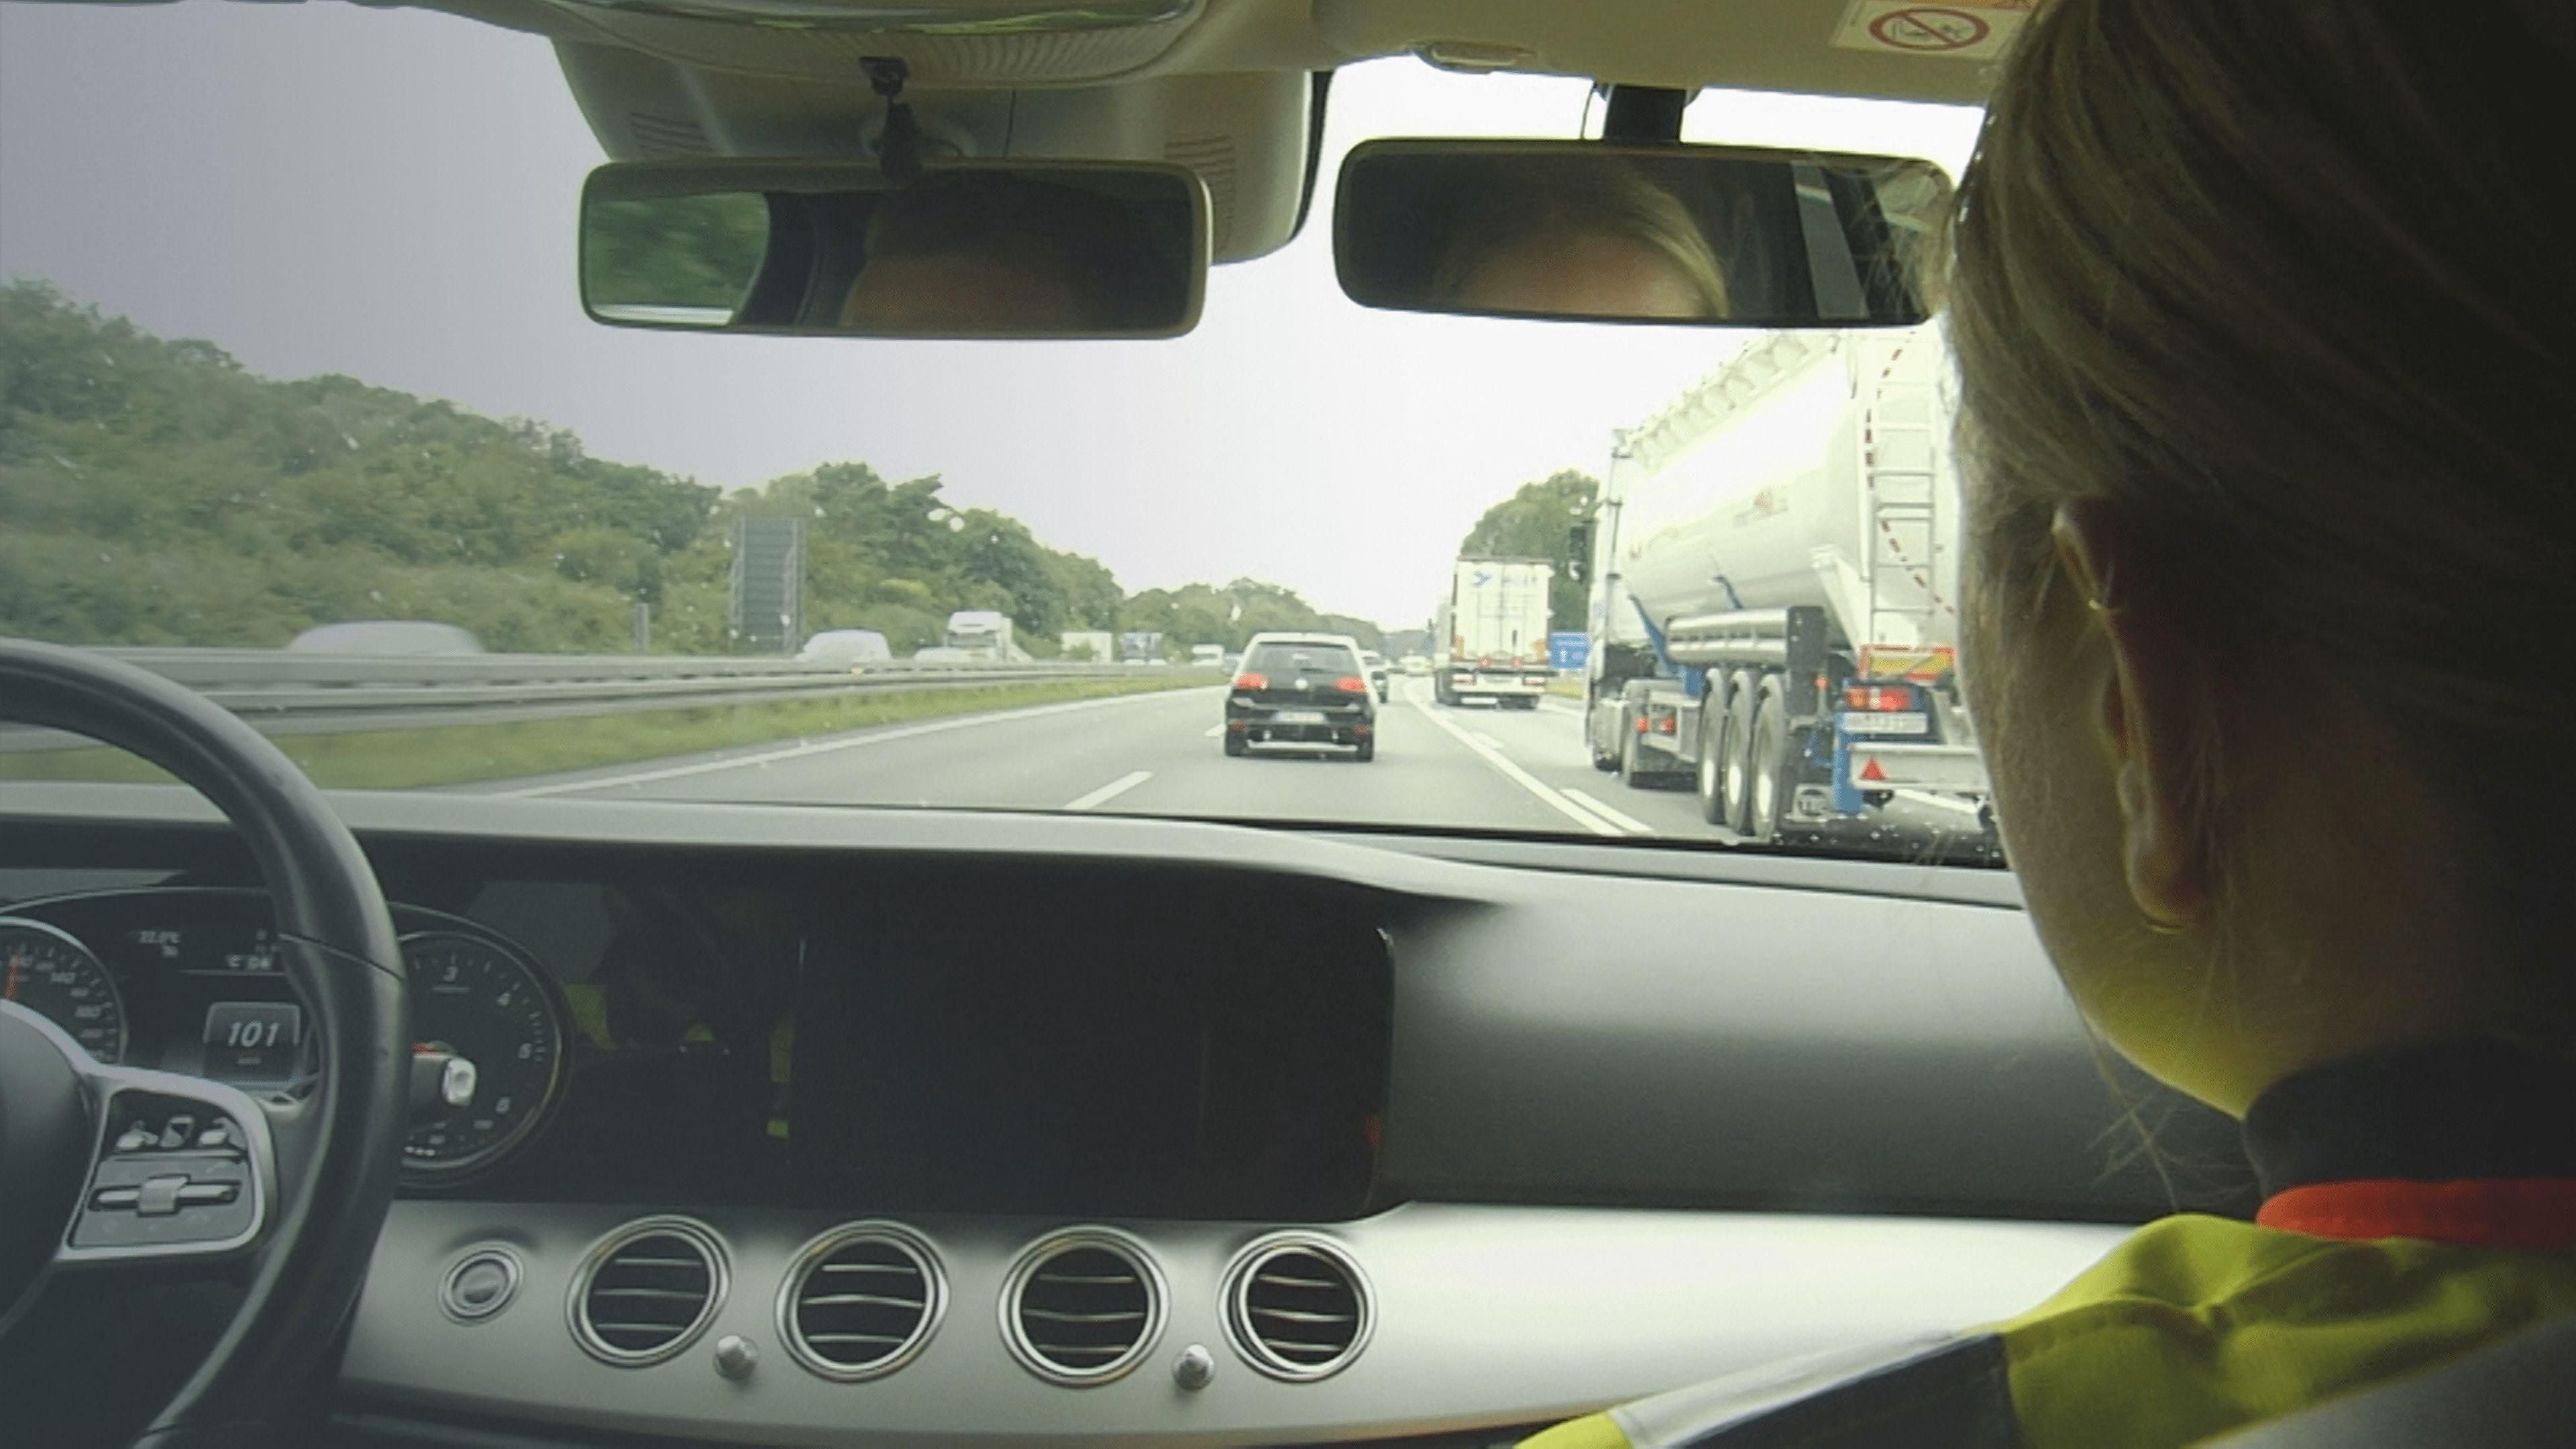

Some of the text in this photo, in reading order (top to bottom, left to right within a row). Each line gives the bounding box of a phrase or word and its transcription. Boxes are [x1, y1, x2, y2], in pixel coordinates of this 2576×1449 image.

[443, 966, 458, 981] 3
[496, 992, 511, 1006] 4
[228, 1020, 280, 1048] 101
